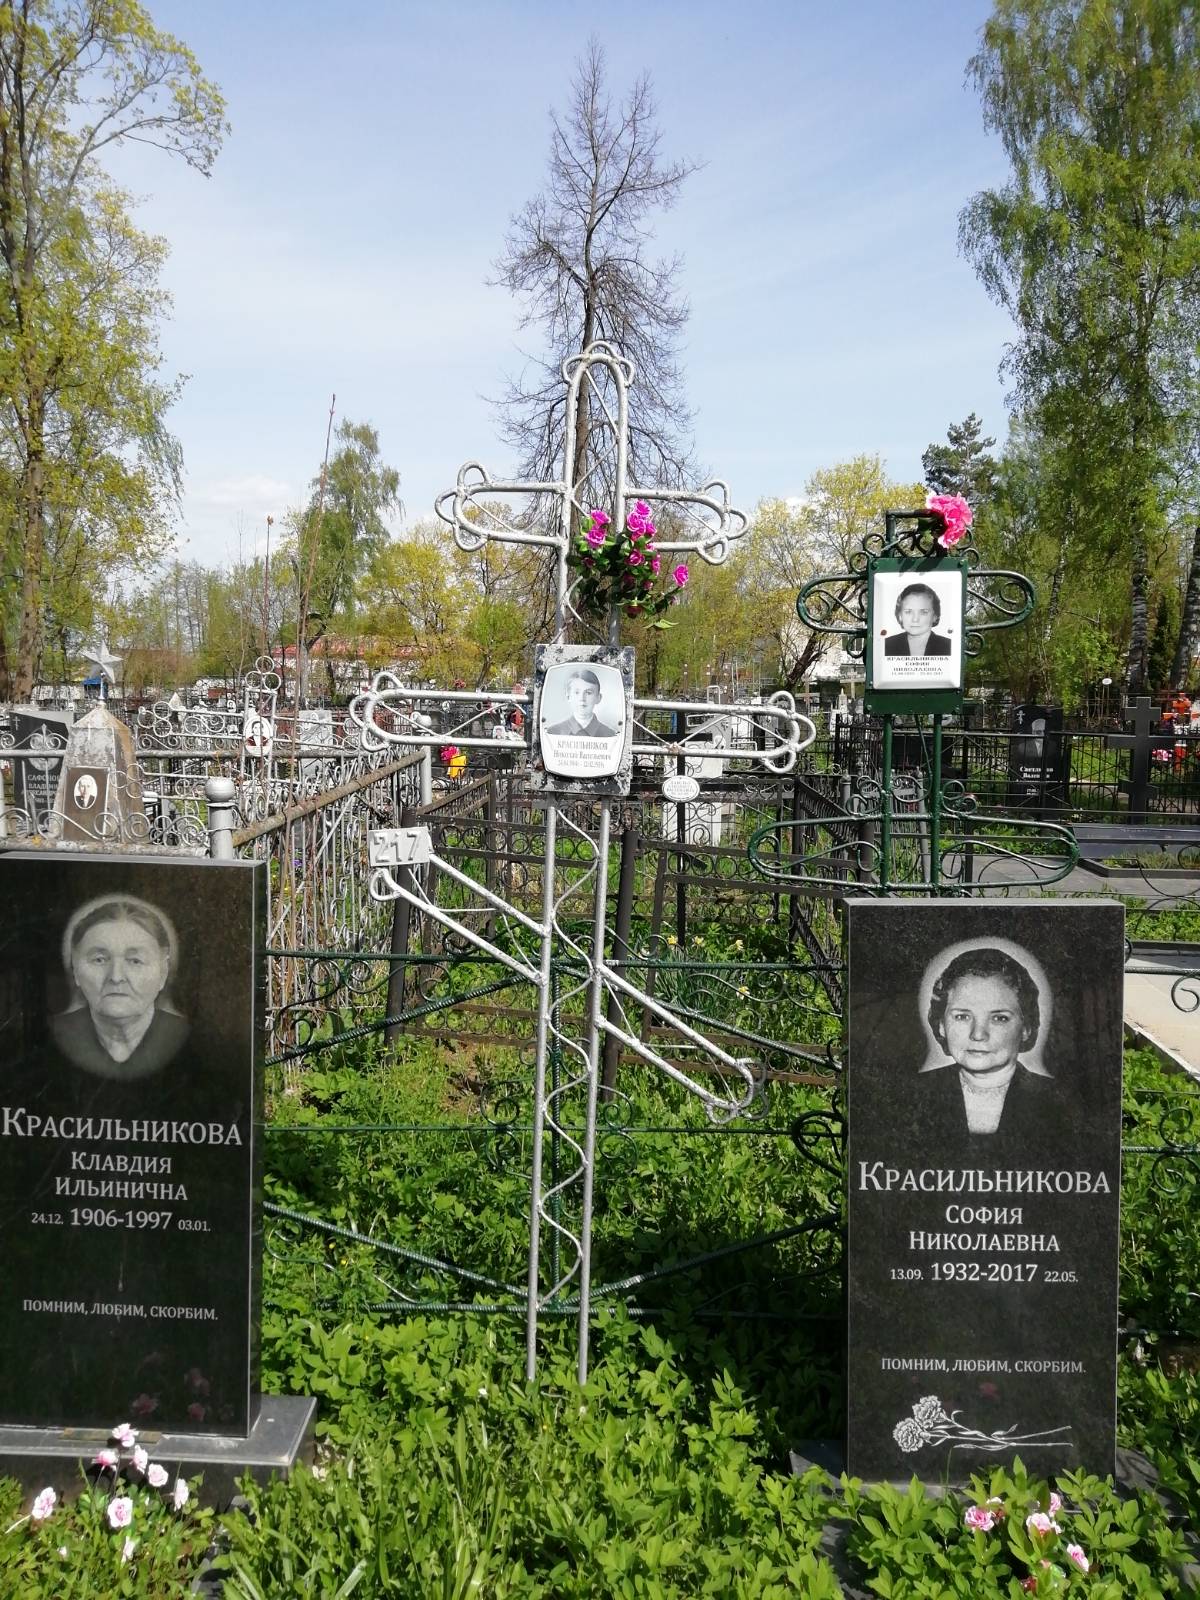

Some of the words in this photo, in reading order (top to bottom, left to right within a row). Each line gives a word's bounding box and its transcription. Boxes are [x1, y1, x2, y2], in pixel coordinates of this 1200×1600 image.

[374, 831, 421, 863] 217
[1, 1106, 243, 1146] КРАСИЛЬНИКОВА
[71, 1151, 172, 1176] КЛАВДИЯ
[55, 1176, 188, 1201] ИЛЬИНИЧНА
[858, 1161, 1111, 1194] КРАСИЛЬНИКОВА
[31, 1212, 64, 1225] 24.12.
[70, 1208, 173, 1230] 1906-1997
[178, 1220, 211, 1232] 03.01.
[945, 1205, 1023, 1225] СОФИЯ
[909, 1231, 1060, 1252] НИКОЛАЕВНА
[890, 1268, 924, 1280] 13.09.
[931, 1263, 1038, 1282] 1932-2017
[1044, 1270, 1079, 1283] 22.05.
[23, 1299, 88, 1315] ПОМНИМ,
[91, 1303, 147, 1318] ЛЮБИМ,
[150, 1305, 218, 1320] СКОРБИМ.
[881, 1358, 950, 1372] ПОМНИМ,
[952, 1359, 1012, 1374] ЛЮБИМ,
[1015, 1360, 1087, 1373] СКОРБИМ.
